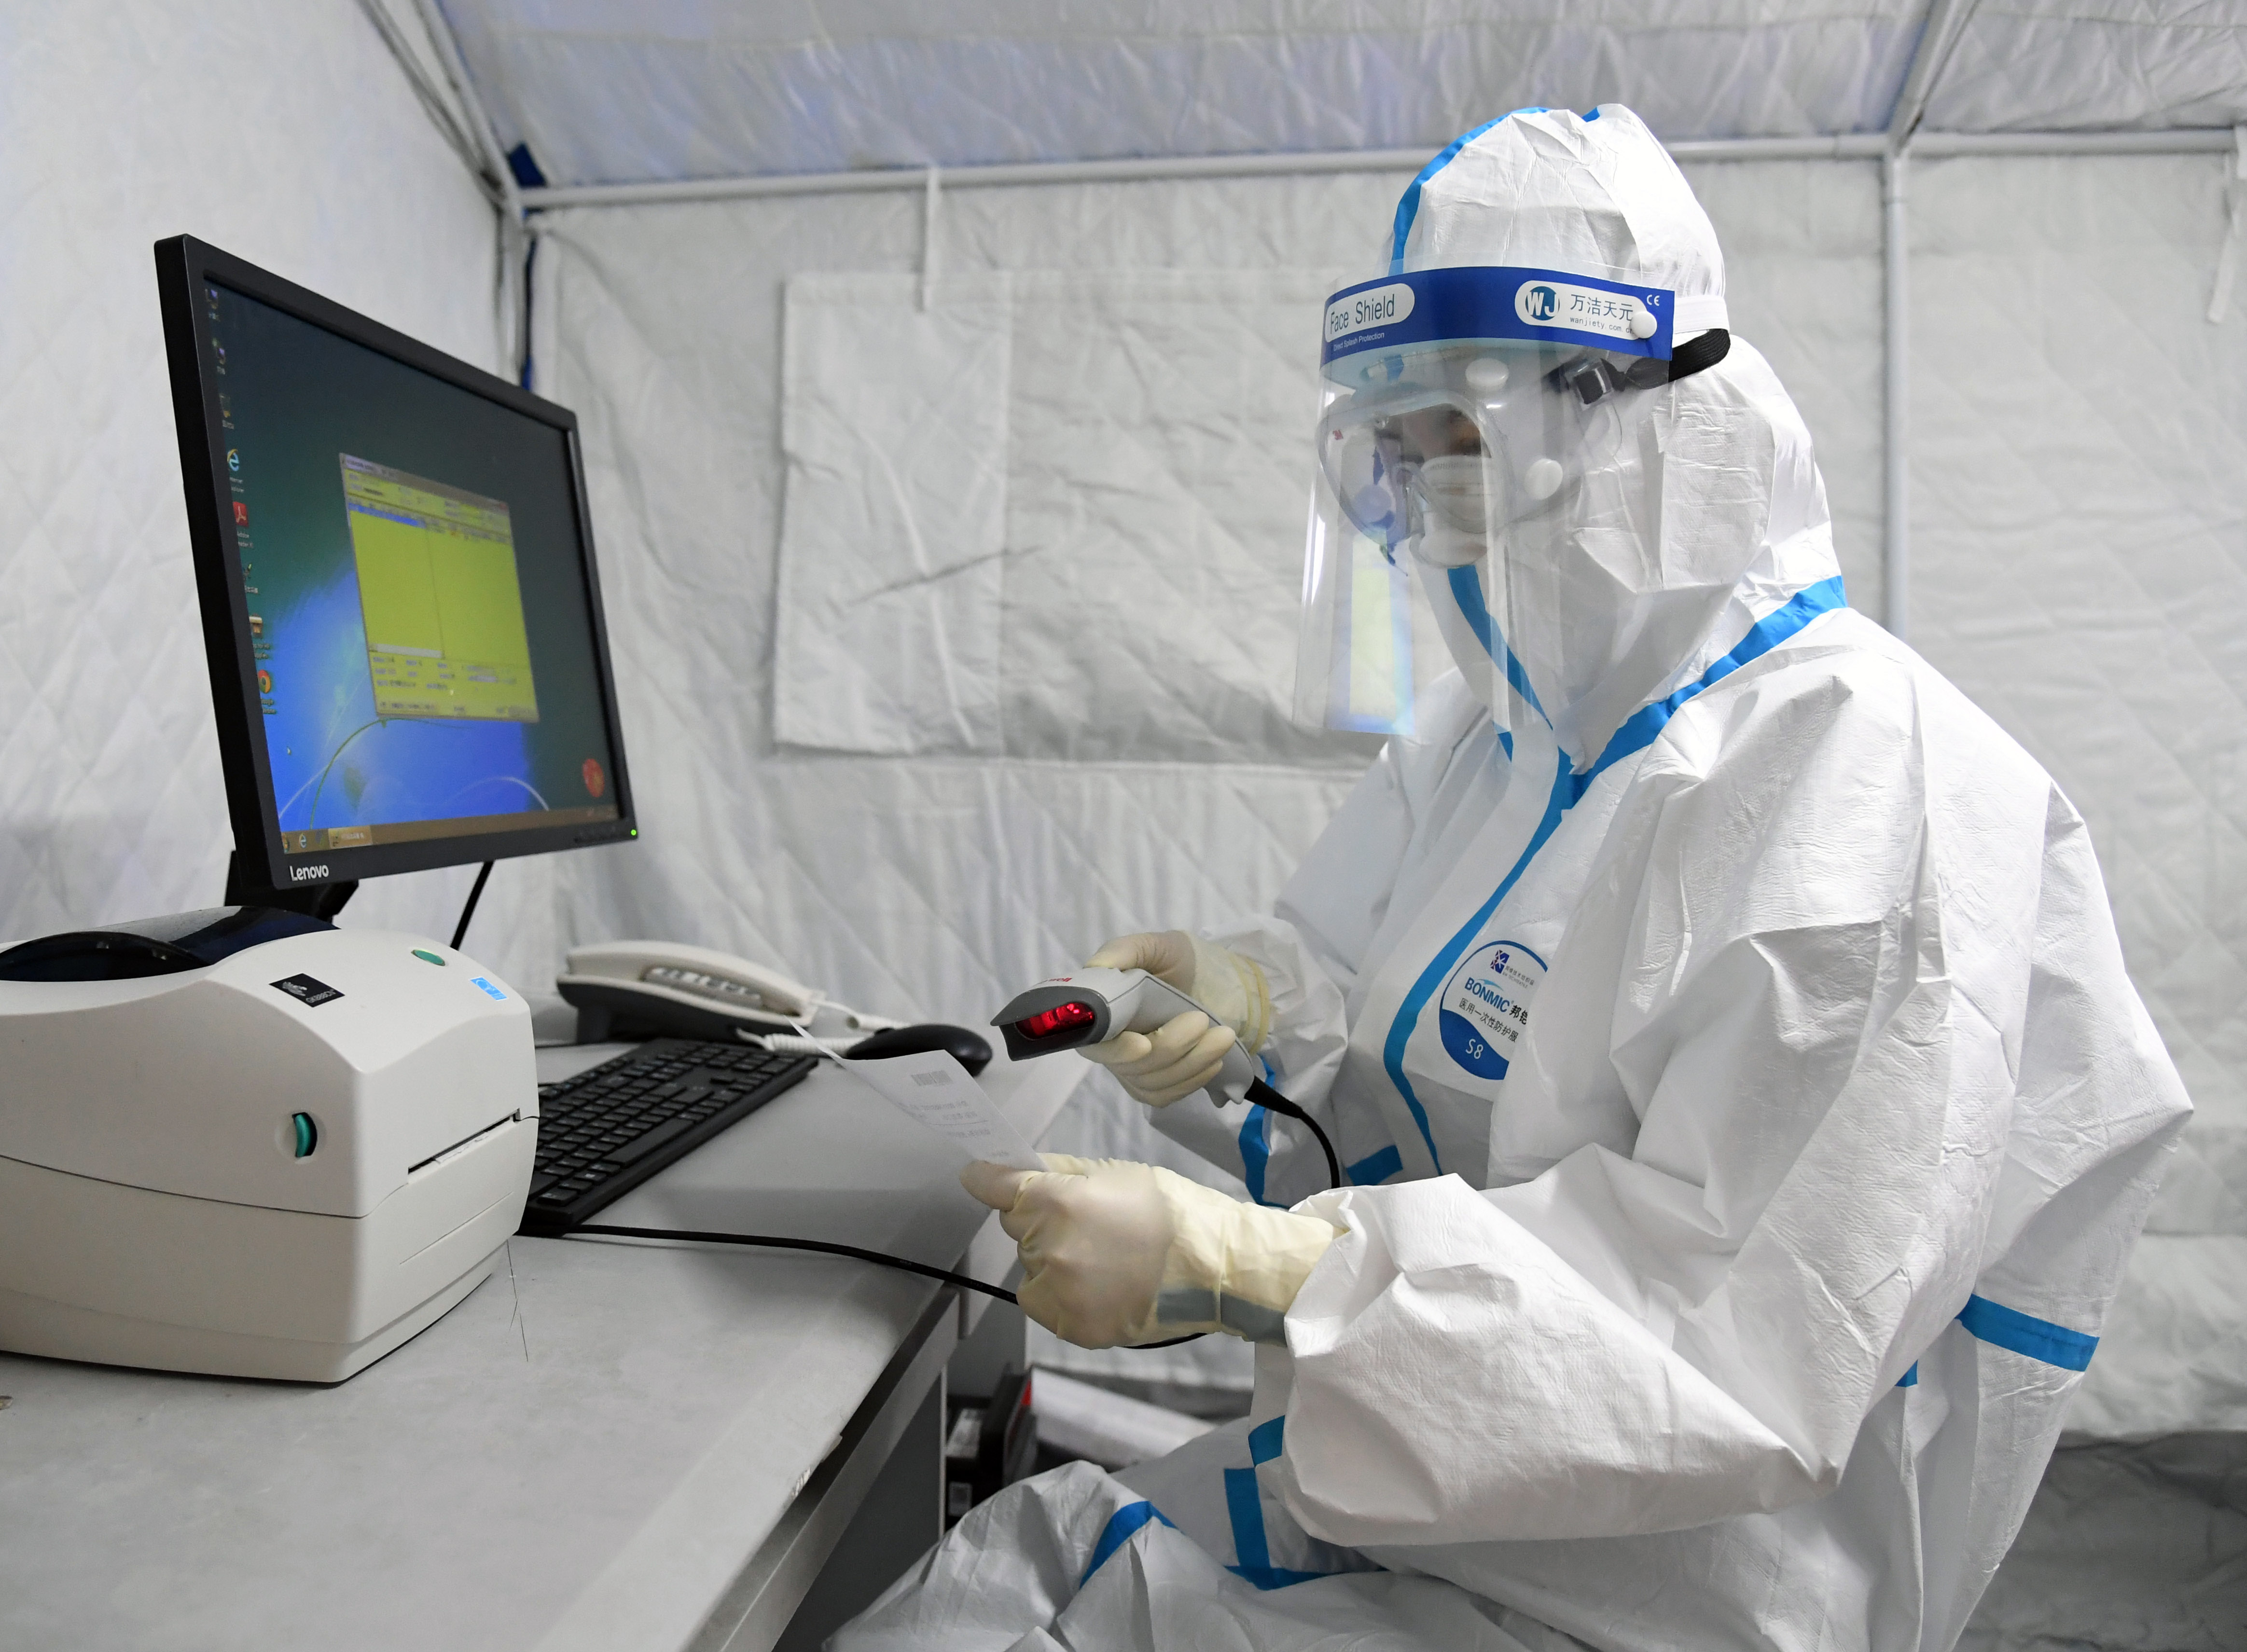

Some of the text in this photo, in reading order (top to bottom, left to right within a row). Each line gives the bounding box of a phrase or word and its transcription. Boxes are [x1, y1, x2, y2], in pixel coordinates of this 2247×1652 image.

[1330, 293, 1395, 334] Face Shield
[1570, 293, 1634, 321] 万洁天元
[1344, 338, 1358, 348] Splash
[1358, 332, 1385, 343] Protection
[289, 865, 329, 882] Lenovo
[1464, 977, 1510, 1013] BONMIC
[1458, 997, 1519, 1043] 医用一次性防护服
[1465, 1038, 1484, 1060] S8
